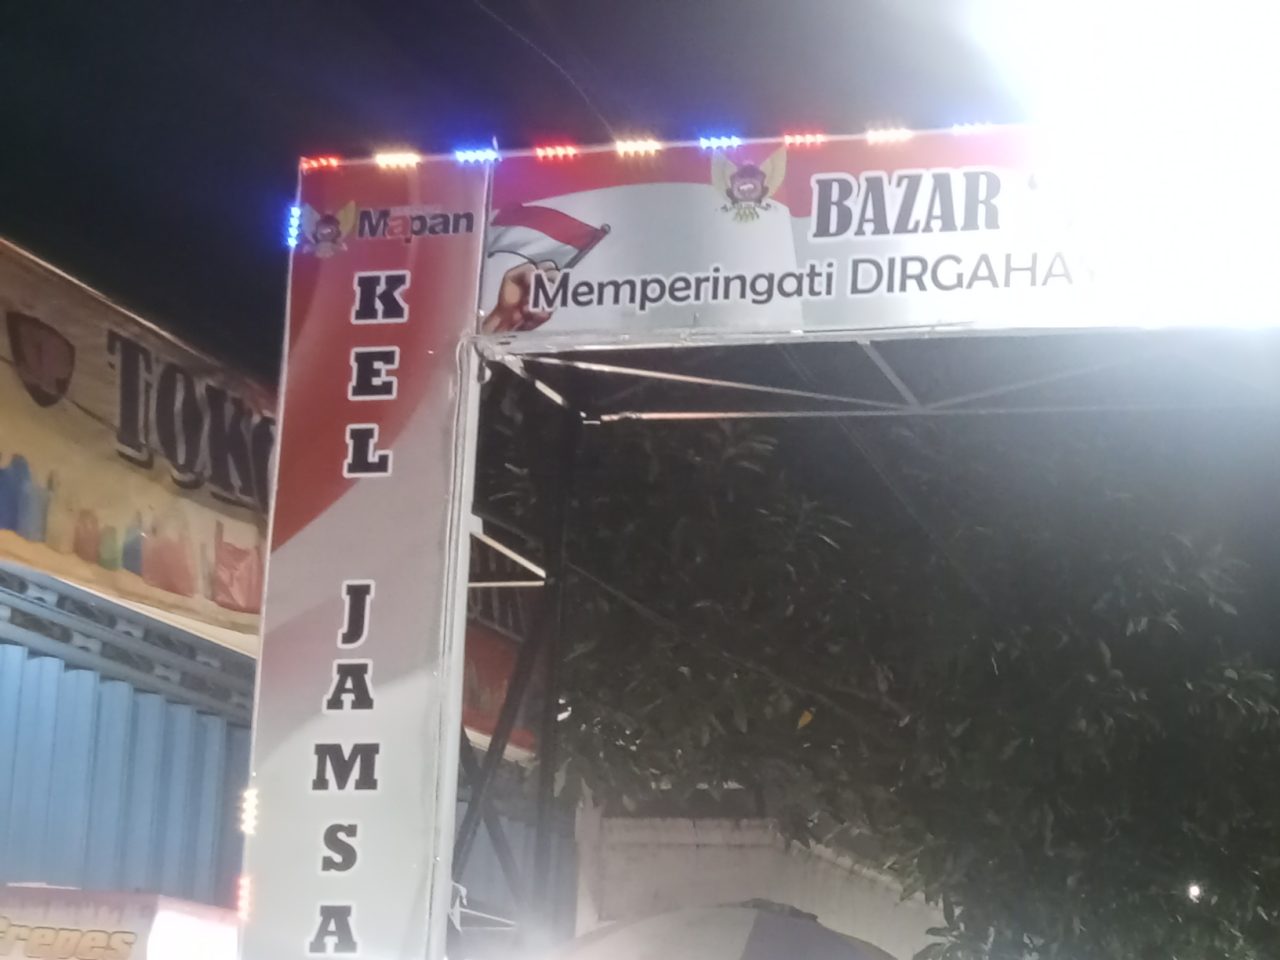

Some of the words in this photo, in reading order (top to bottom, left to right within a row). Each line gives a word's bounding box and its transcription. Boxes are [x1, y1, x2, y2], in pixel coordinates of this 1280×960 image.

[358, 209, 475, 244] Mapan
[812, 169, 1002, 240] BAZAR
[531, 259, 834, 310] Memperingati
[849, 251, 1076, 296] DIRGAHA
[346, 272, 409, 476] KEL
